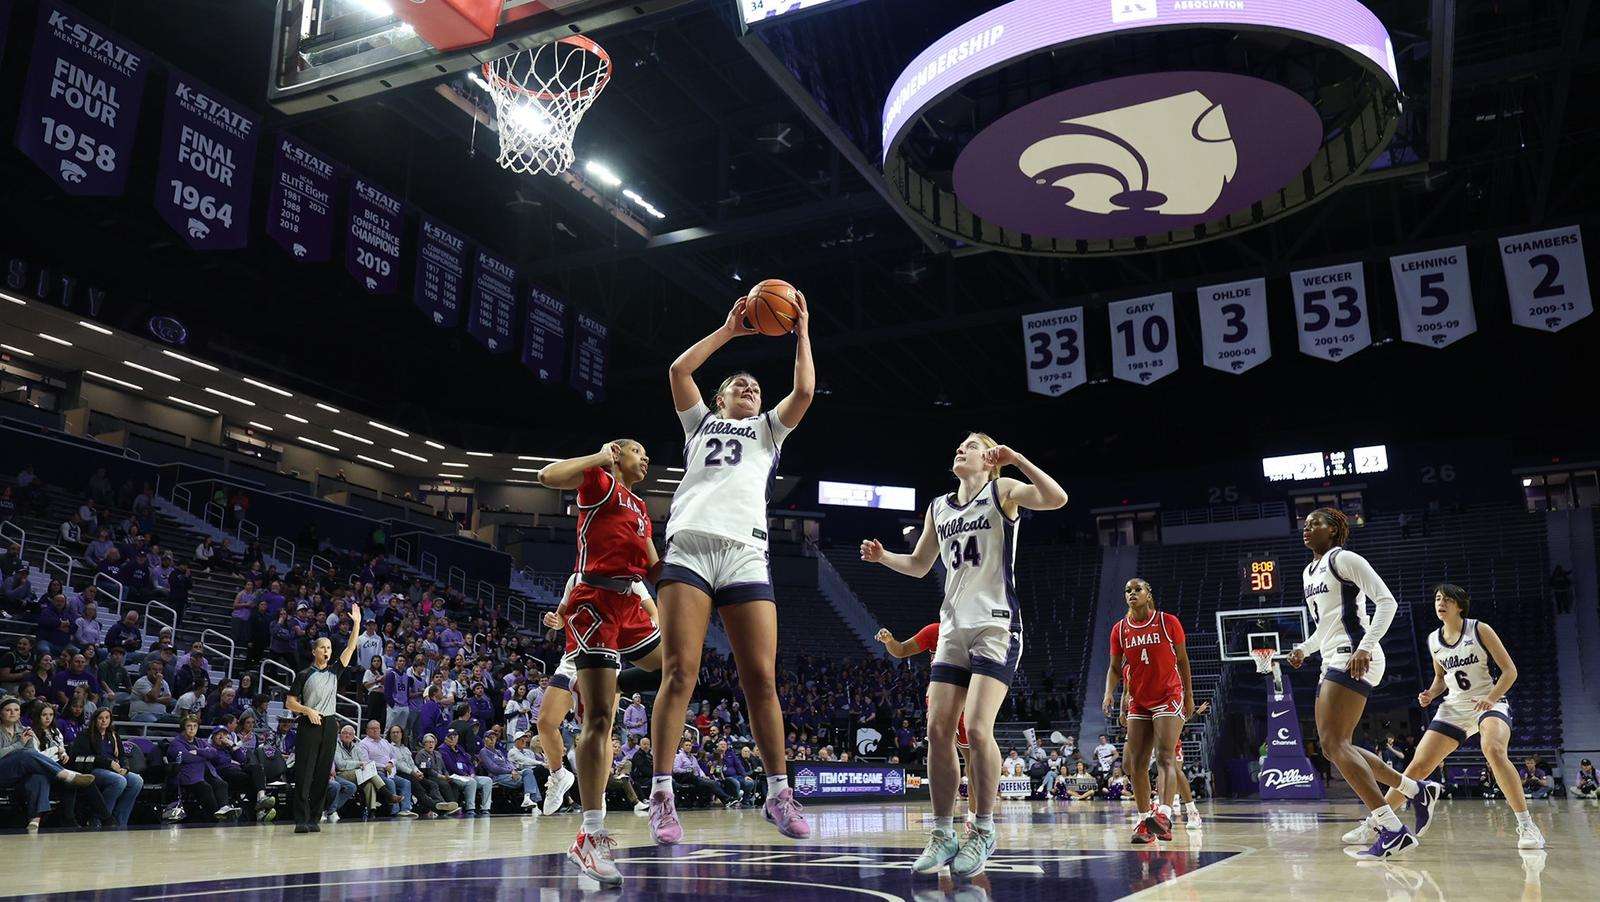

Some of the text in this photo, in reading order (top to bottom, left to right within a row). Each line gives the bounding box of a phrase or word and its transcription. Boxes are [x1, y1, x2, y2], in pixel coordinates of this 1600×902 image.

[48, 10, 141, 72] K-STATE
[82, 43, 132, 78] BASKETBALL
[54, 57, 120, 109] FINAL
[50, 78, 117, 128] FOUR
[175, 82, 253, 135] K-STATE
[41, 117, 116, 172] 1958
[181, 125, 236, 170] FINAL
[178, 144, 233, 187] FOUR
[281, 140, 334, 176] K-STATE
[281, 172, 329, 203] ELITE EIGHT
[284, 189, 301, 202] 1981
[356, 180, 400, 213] K-STATE
[171, 180, 233, 229] 1964
[281, 208, 300, 223] 2010
[283, 198, 301, 213] 1988
[280, 218, 299, 233] 2018
[353, 215, 400, 246] CONFERENCE
[364, 209, 390, 230] BIG 12
[351, 224, 399, 257] CHAMPIONS
[424, 222, 463, 250] K-STATE
[1503, 233, 1578, 255] CHAMBERS
[357, 247, 390, 276] 2019
[479, 253, 515, 279] K-STATE
[1401, 255, 1458, 273] LEHNING
[1303, 272, 1353, 287] WECKER
[1528, 254, 1565, 300] 2
[532, 288, 565, 313] K-STATE
[1212, 288, 1252, 302] OHLDE
[1420, 272, 1450, 316] 5
[1126, 303, 1155, 315] GARY
[1303, 286, 1362, 332] 53
[1528, 302, 1575, 317] 2009-13
[578, 313, 608, 336] K-STATE
[1027, 314, 1078, 329] ROMSTAD
[1221, 303, 1249, 344] 3
[1417, 320, 1460, 333] 2005-09
[1116, 315, 1169, 357] 10
[1314, 334, 1355, 346] 2001-05
[1029, 328, 1080, 370] 33
[1218, 347, 1256, 360] 2000-04
[1127, 359, 1163, 371] 1981-83
[1038, 371, 1072, 384] 1979-82
[701, 421, 757, 440] Wildcats
[704, 438, 745, 467] 23
[1421, 464, 1457, 483] 26
[1209, 485, 1240, 503] 25
[937, 514, 991, 541] Wildcats
[950, 535, 981, 571] 34
[1251, 560, 1275, 573] 8:08
[1250, 572, 1273, 592] 30
[1125, 633, 1161, 649] LAMAR
[1140, 648, 1150, 665] 4
[1440, 653, 1479, 670] Wildcats
[1454, 670, 1471, 691] 6
[819, 772, 837, 784] ITEM
[838, 772, 848, 784] OF
[848, 772, 862, 784] THE
[863, 772, 883, 784] GAME
[1001, 781, 1031, 791] DEFENSE
[1258, 768, 1314, 789] Dillons
